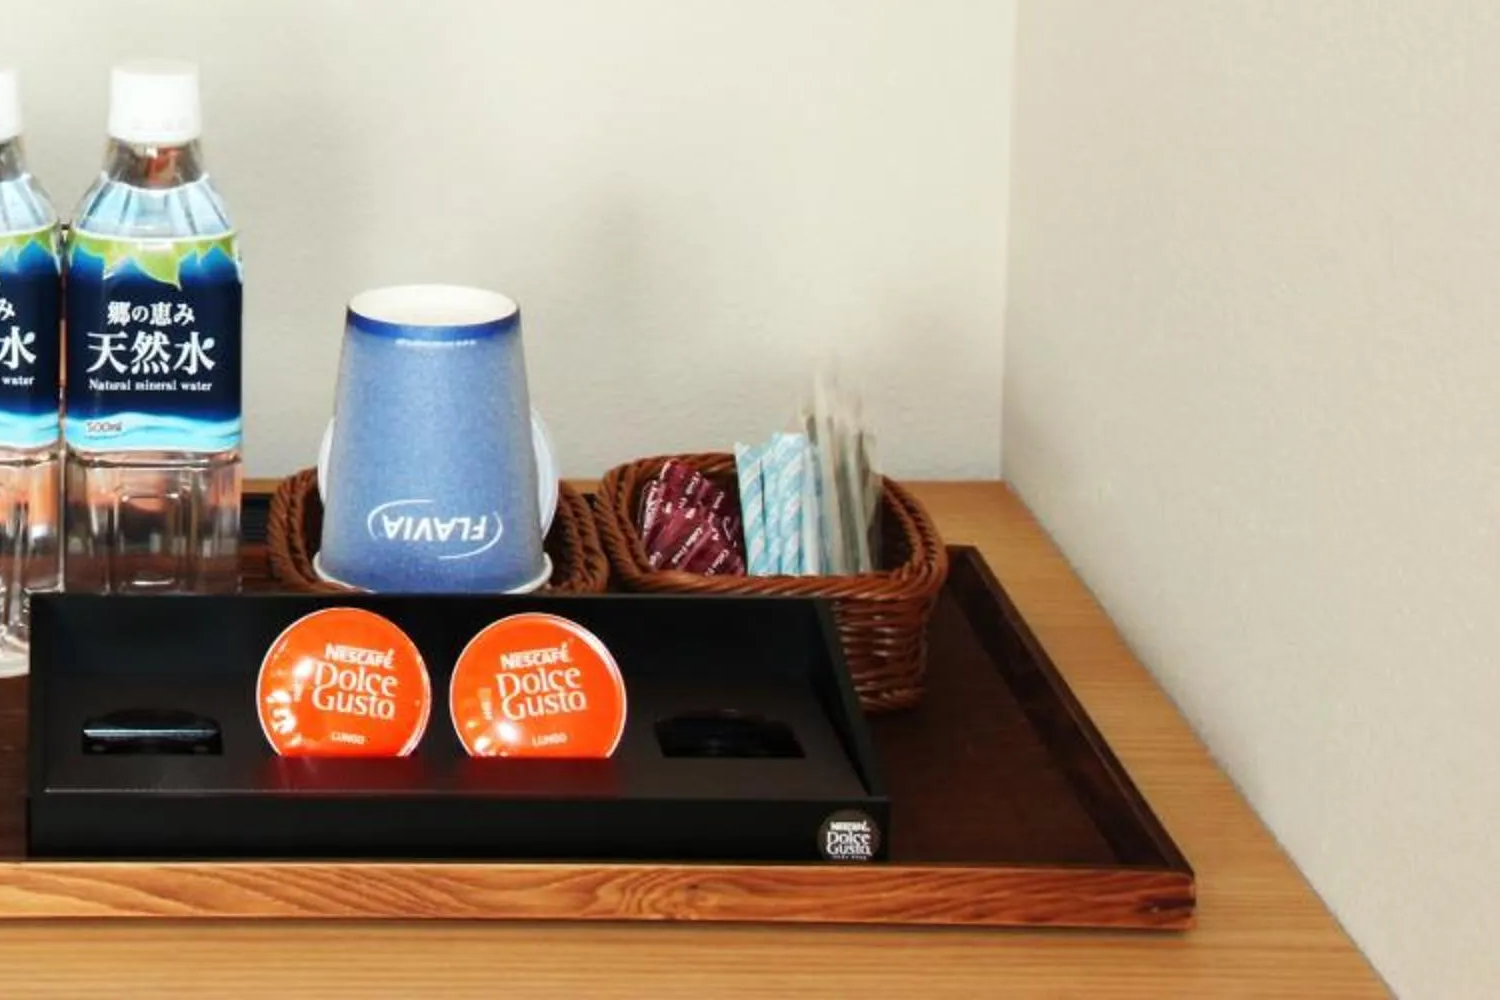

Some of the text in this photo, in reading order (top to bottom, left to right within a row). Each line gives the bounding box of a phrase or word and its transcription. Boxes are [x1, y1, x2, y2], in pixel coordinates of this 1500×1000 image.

[107, 301, 195, 326] 郷の恵み
[86, 331, 216, 375] 天然水
[2, 375, 35, 386] water
[88, 378, 213, 391] Natural mineral water
[382, 514, 487, 541] FLAVIA
[313, 660, 398, 697] Dolce
[496, 667, 582, 697] Dolce
[312, 685, 396, 720] Gusto
[501, 691, 587, 721] Gusto
